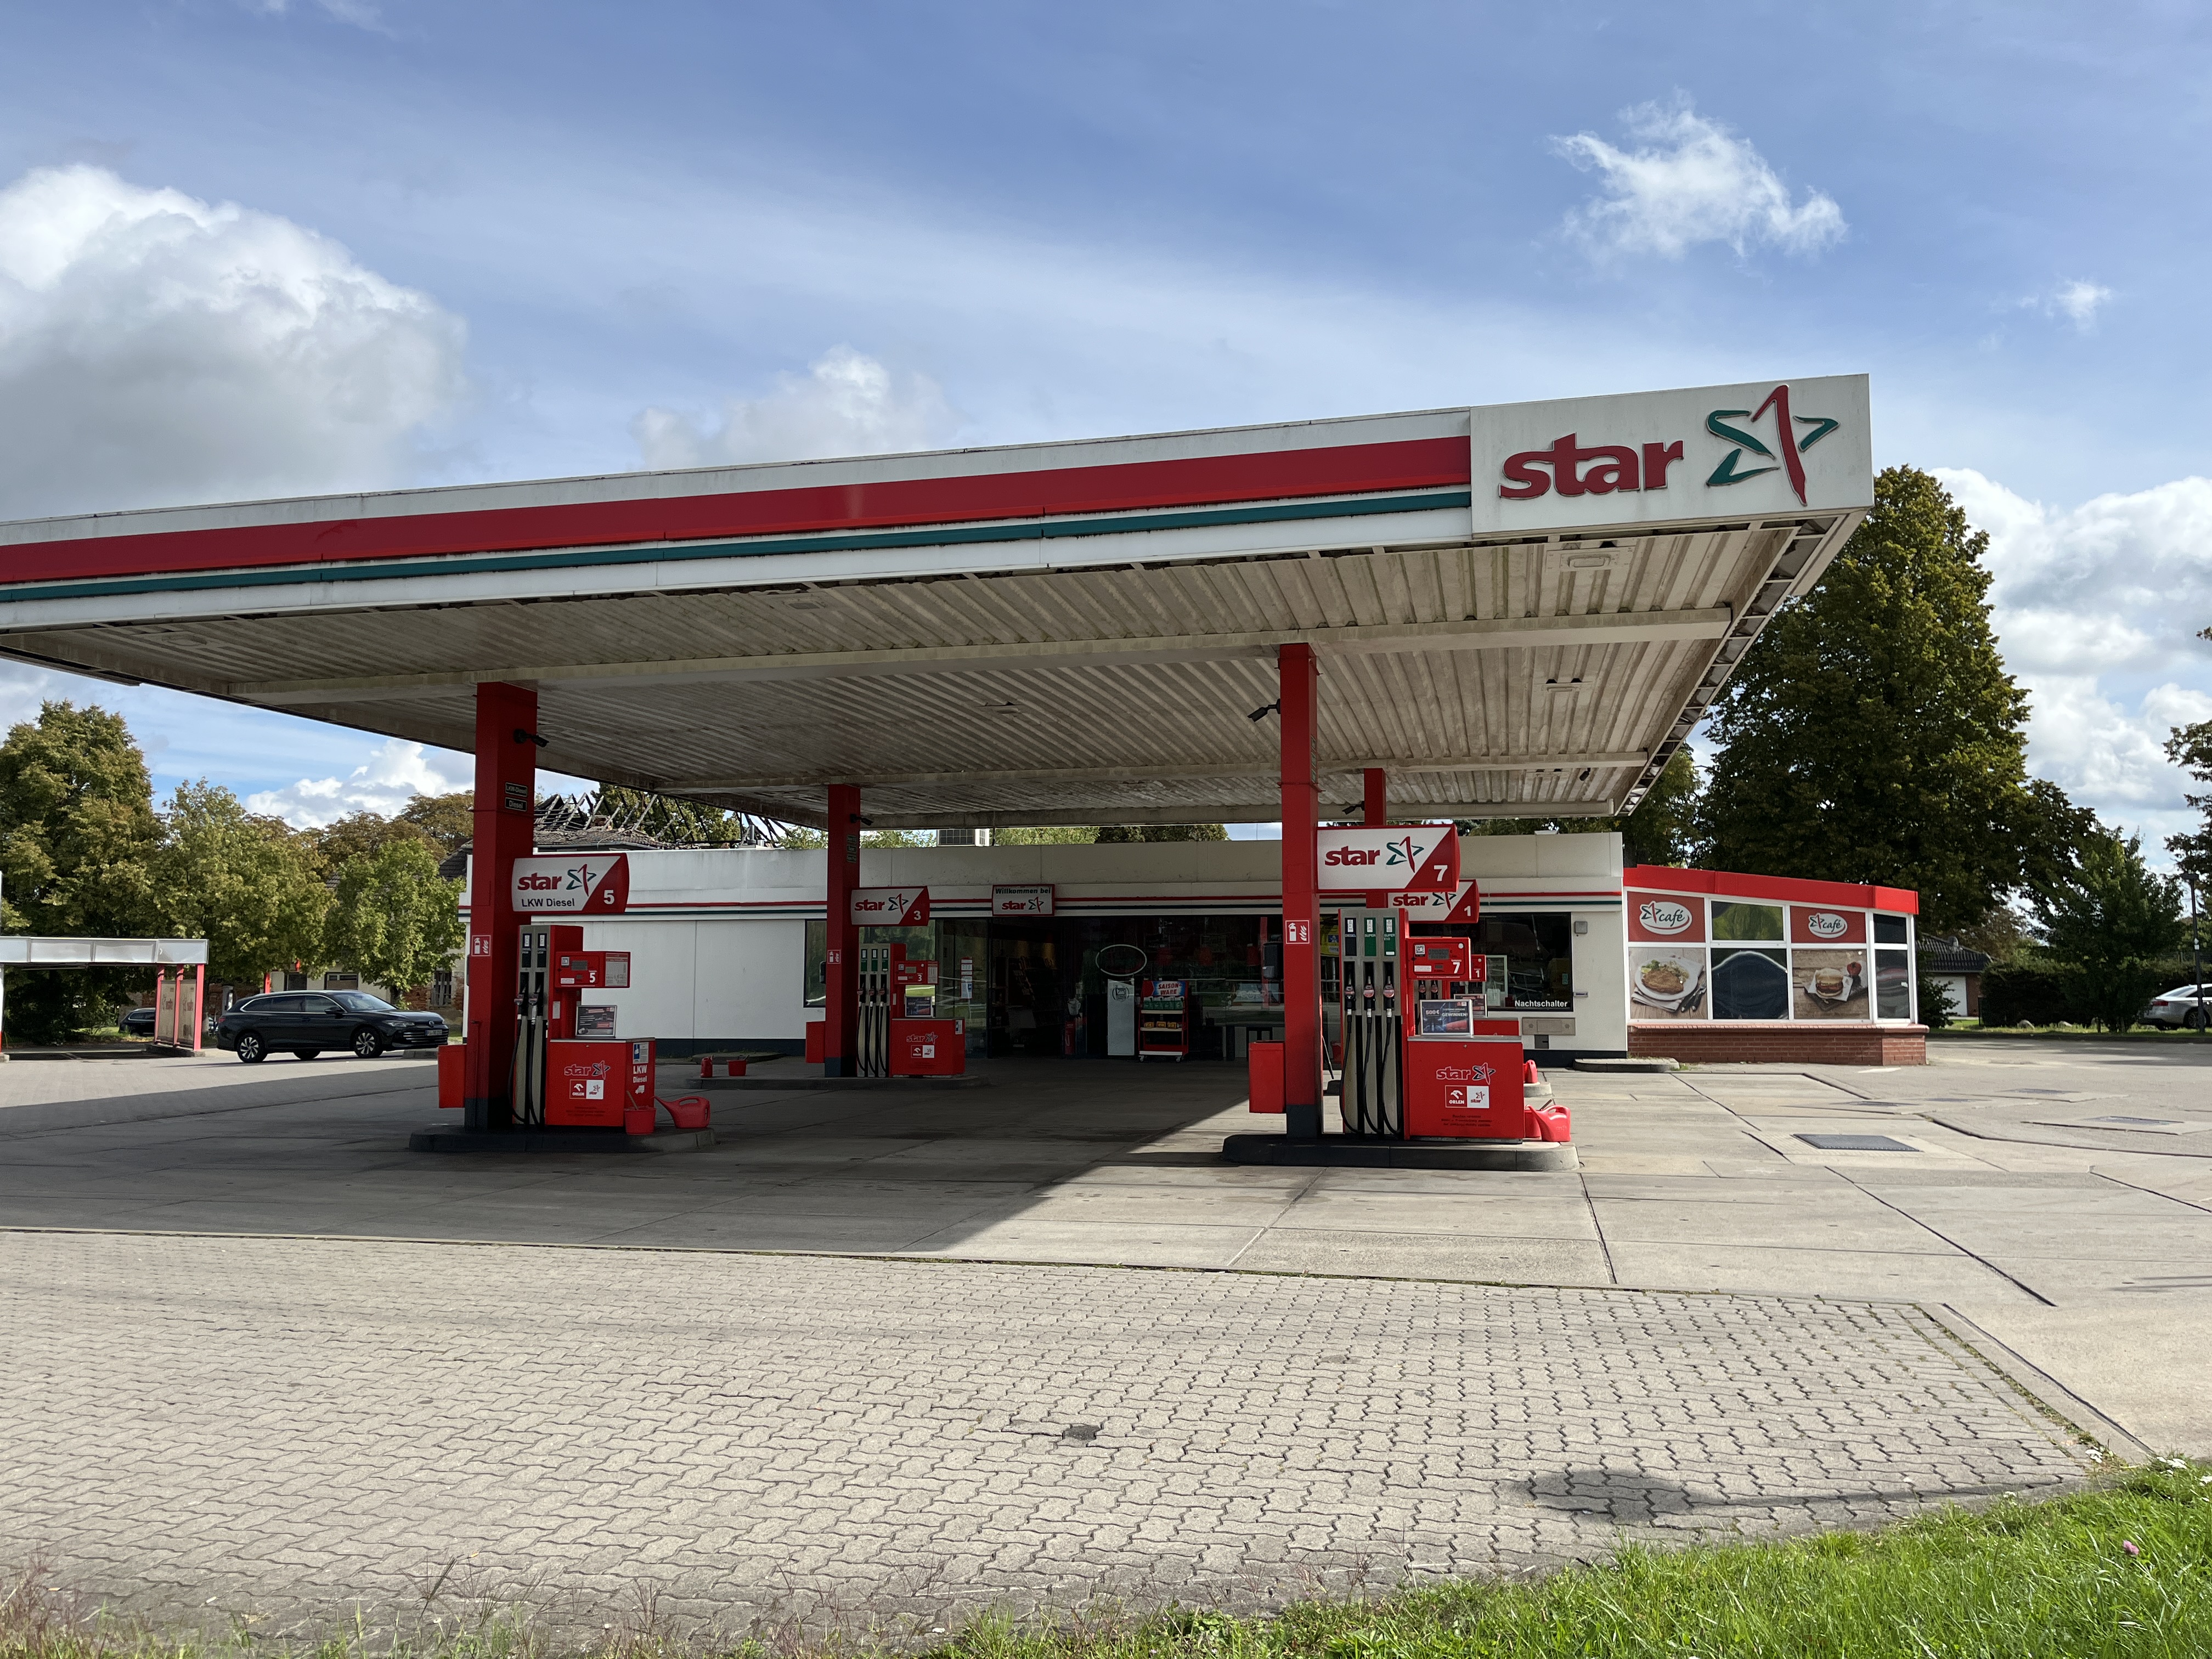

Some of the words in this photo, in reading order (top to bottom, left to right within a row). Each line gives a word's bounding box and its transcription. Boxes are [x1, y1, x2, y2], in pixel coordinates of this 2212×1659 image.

[1499, 432, 1683, 499] star
[1324, 846, 1380, 866] star
[1434, 865, 1448, 882] 7
[517, 872, 562, 890] star
[521, 899, 543, 907] LKW
[546, 898, 575, 907] Diesel
[603, 889, 614, 904] 5
[1392, 893, 1429, 906] star
[854, 899, 885, 911] star
[1002, 900, 1026, 910] star
[1464, 906, 1471, 916] 1
[913, 911, 921, 921] 3
[1658, 909, 1685, 927] café
[1822, 919, 1842, 932] café
[1453, 962, 1460, 974] 7
[1475, 969, 1480, 978] 1
[589, 973, 596, 983] 5
[906, 1034, 926, 1042] star
[564, 1064, 591, 1076] star
[633, 1065, 647, 1074] LKW
[1436, 1066, 1471, 1080] star
